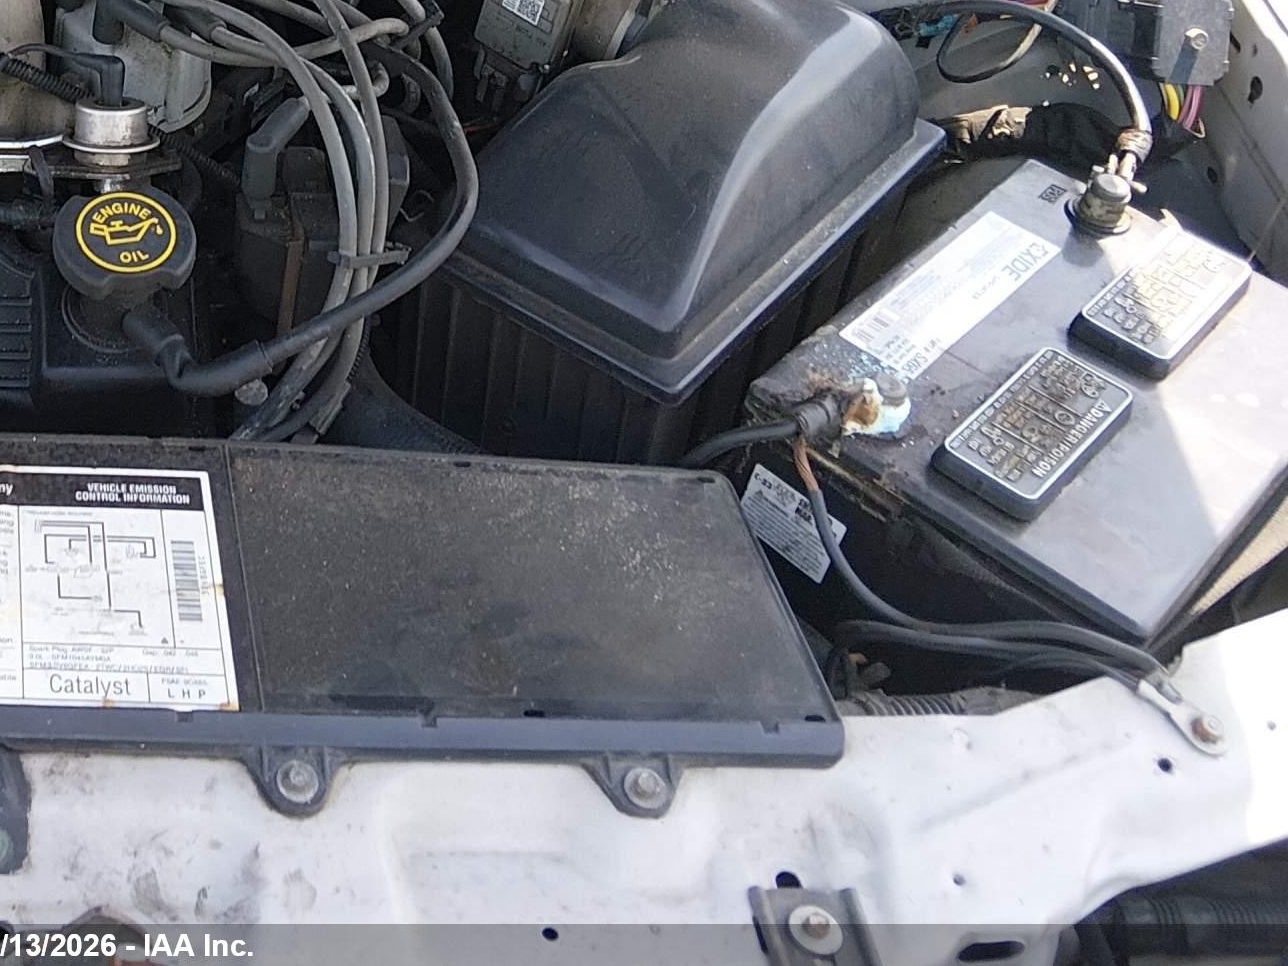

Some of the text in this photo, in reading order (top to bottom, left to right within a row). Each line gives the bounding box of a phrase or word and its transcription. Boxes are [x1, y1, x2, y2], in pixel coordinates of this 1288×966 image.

[92, 202, 152, 224] ENGINE
[119, 250, 150, 263] OIL
[1002, 242, 1049, 281] EXIDE
[87, 483, 177, 494] VEHICLE EMISSION
[75, 492, 190, 504] CONTROL INFORMATION
[49, 673, 132, 699] Catalyst
[167, 688, 206, 699] L H P
